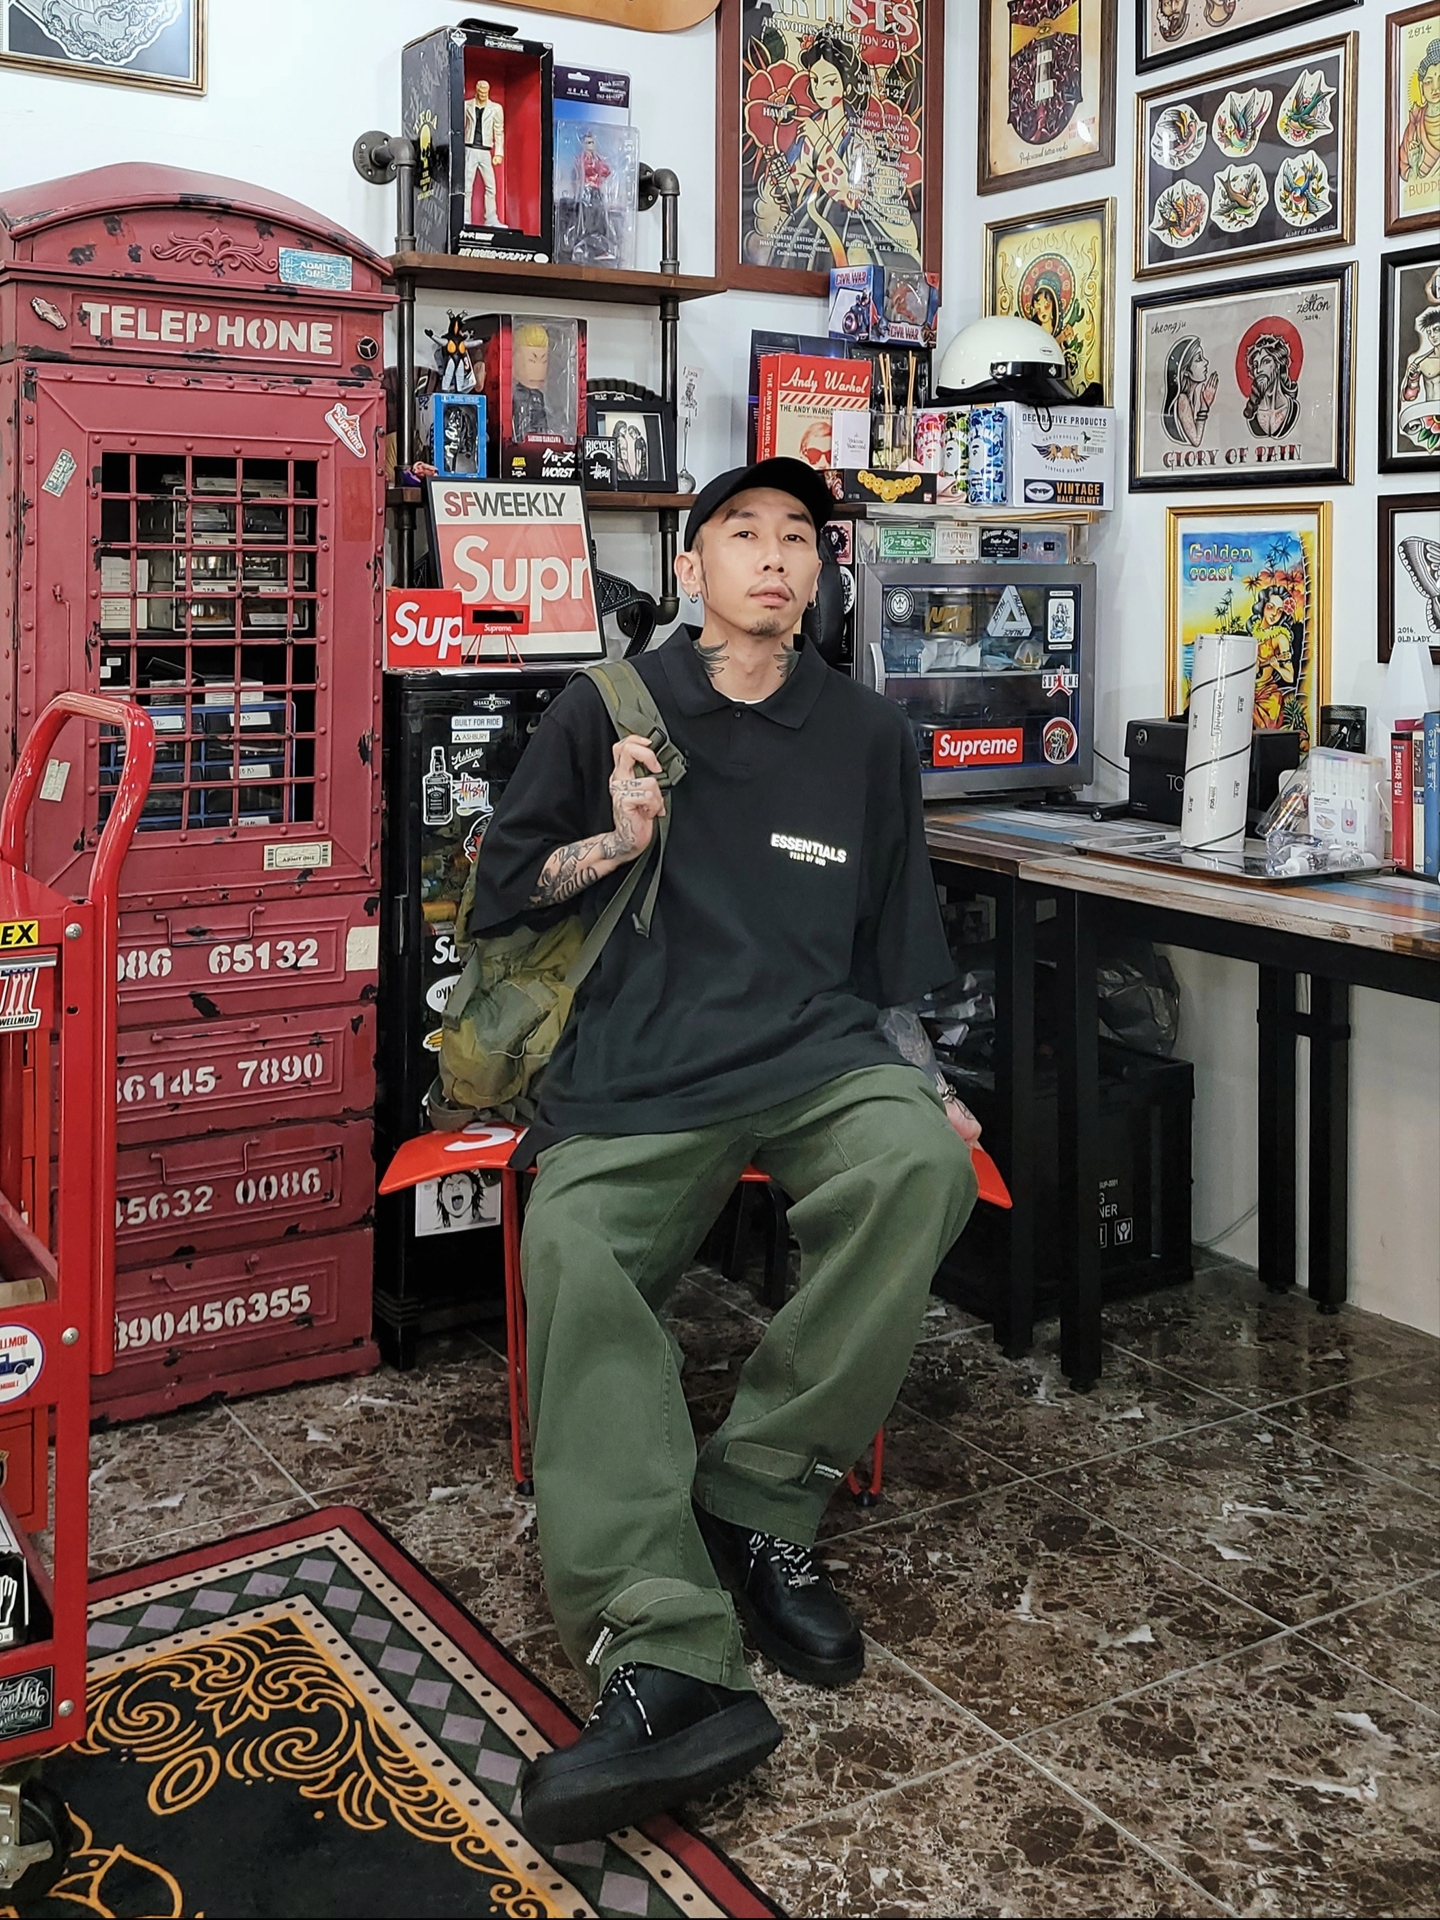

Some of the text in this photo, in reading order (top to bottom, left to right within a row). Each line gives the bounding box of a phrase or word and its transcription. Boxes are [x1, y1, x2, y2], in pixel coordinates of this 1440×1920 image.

[761, 16, 819, 36] ARTWORKS
[881, 38, 908, 51] 2016
[879, 87, 906, 99] 21-22
[836, 270, 867, 287] CIVIL WAR
[82, 301, 334, 355] TELEPHONE
[889, 324, 919, 341] CIVIL WAR
[781, 366, 869, 394] Andy Warhol
[765, 390, 773, 411] ANDY
[780, 404, 792, 412] THE
[793, 405, 811, 414] ANDY
[811, 406, 839, 415] WARHO
[334, 410, 363, 451] Supreme
[764, 413, 772, 446] WARHOL
[1070, 416, 1107, 427] PRODUCTS
[585, 439, 615, 457] BICYCLE
[1162, 444, 1302, 471] GLORY OF PAIN
[541, 466, 576, 478] WORST
[1056, 482, 1100, 496] VINTAGE
[1056, 495, 1100, 505] HALF HELMET
[1189, 541, 1253, 563] Golden
[1189, 564, 1234, 582] coast
[1012, 594, 1026, 617] PALACE
[1397, 635, 1411, 643] OLD
[1043, 674, 1079, 688] SUPEME
[454, 717, 500, 727] BUILT FOR RIDE
[938, 733, 1018, 763] Supreme
[1428, 729, 1438, 759] 위대한
[451, 746, 484, 769] Ashbury
[770, 832, 847, 864] ESSENTIALS
[789, 851, 805, 862] FEAR
[208, 938, 319, 975] 65132
[237, 1052, 323, 1088] 7890
[235, 1167, 321, 1205] 0086
